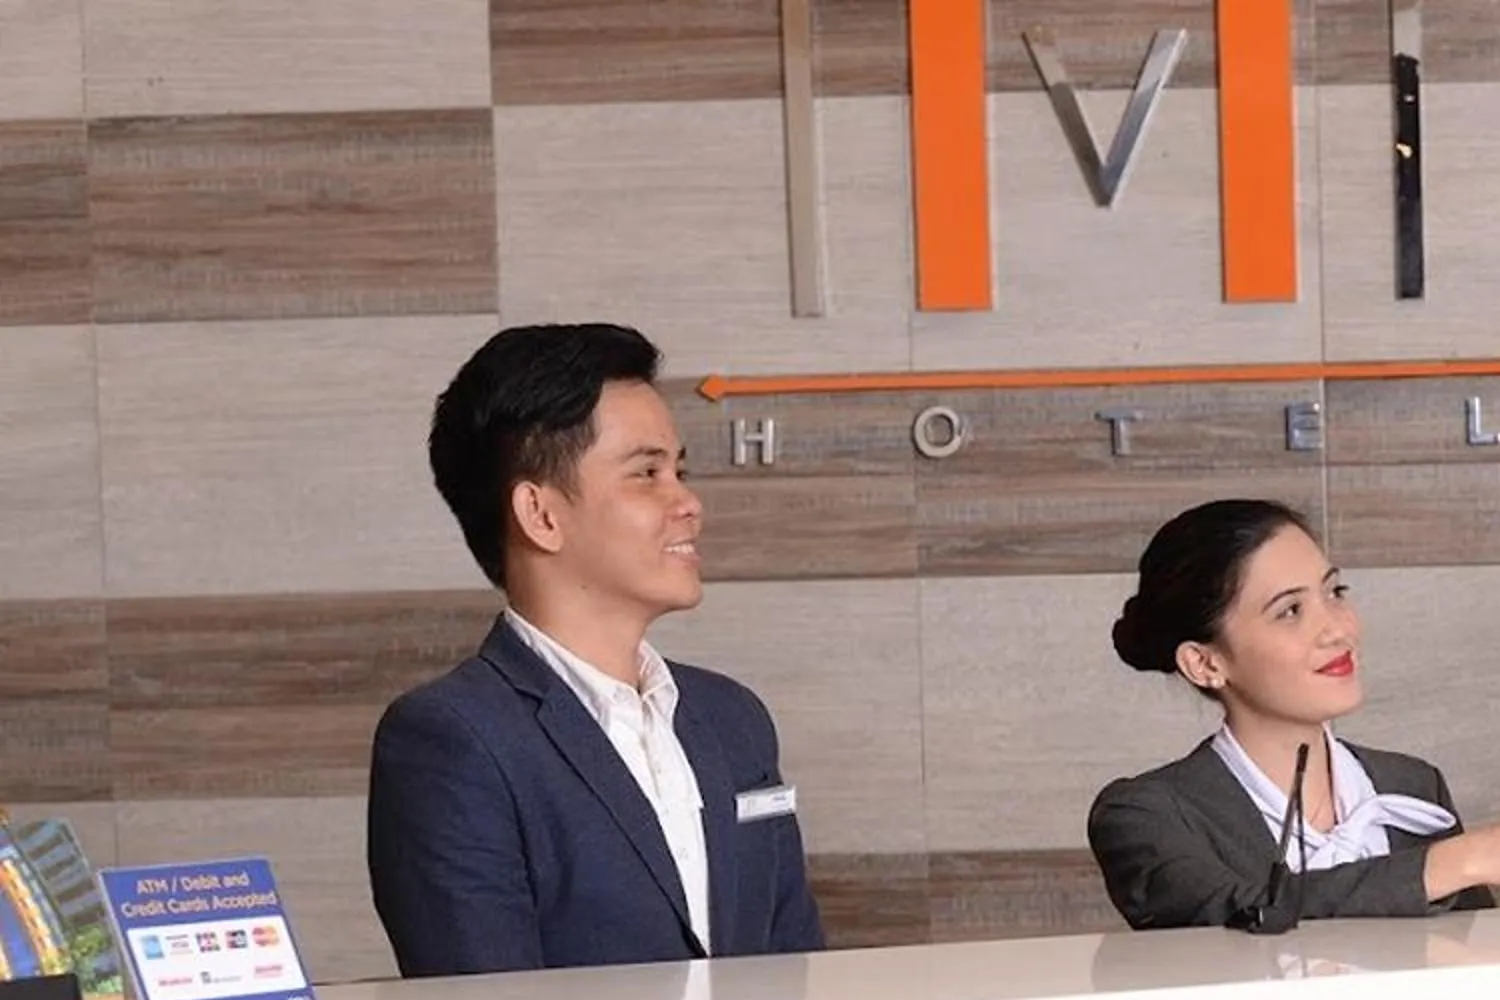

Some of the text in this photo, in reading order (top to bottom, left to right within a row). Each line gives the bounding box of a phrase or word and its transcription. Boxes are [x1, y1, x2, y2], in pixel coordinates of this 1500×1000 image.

[137, 879, 169, 894] ATM
[180, 874, 221, 892] Debit
[223, 871, 250, 887] and
[121, 890, 277, 918] Credit Cards Accepted
